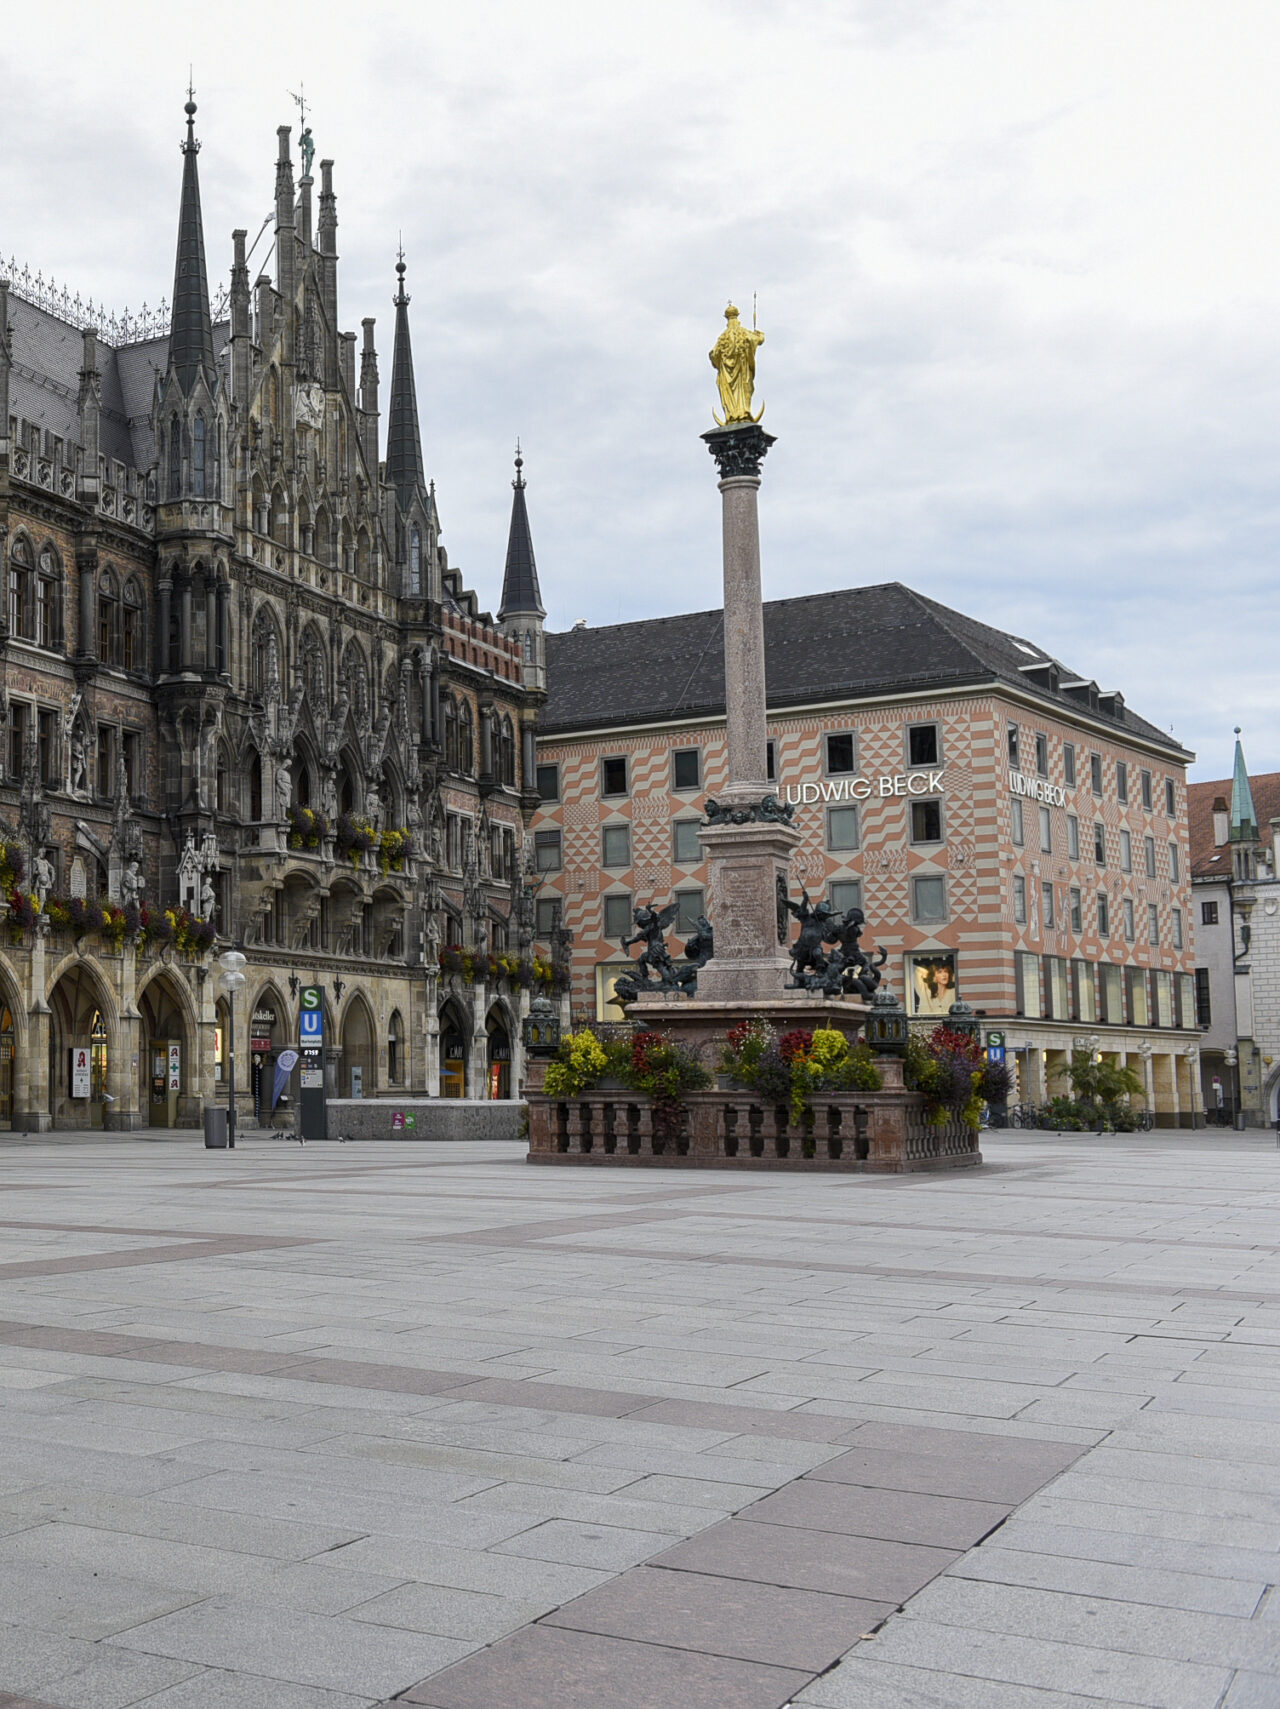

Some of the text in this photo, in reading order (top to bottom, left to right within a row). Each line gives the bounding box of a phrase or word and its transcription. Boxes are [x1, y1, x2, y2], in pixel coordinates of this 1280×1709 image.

[879, 771, 945, 798] BECK
[1009, 770, 1067, 808] LUDWIG BECK
[304, 989, 318, 1008] S
[304, 1013, 318, 1032] U
[990, 1033, 1001, 1046] S
[990, 1048, 1000, 1061] U
